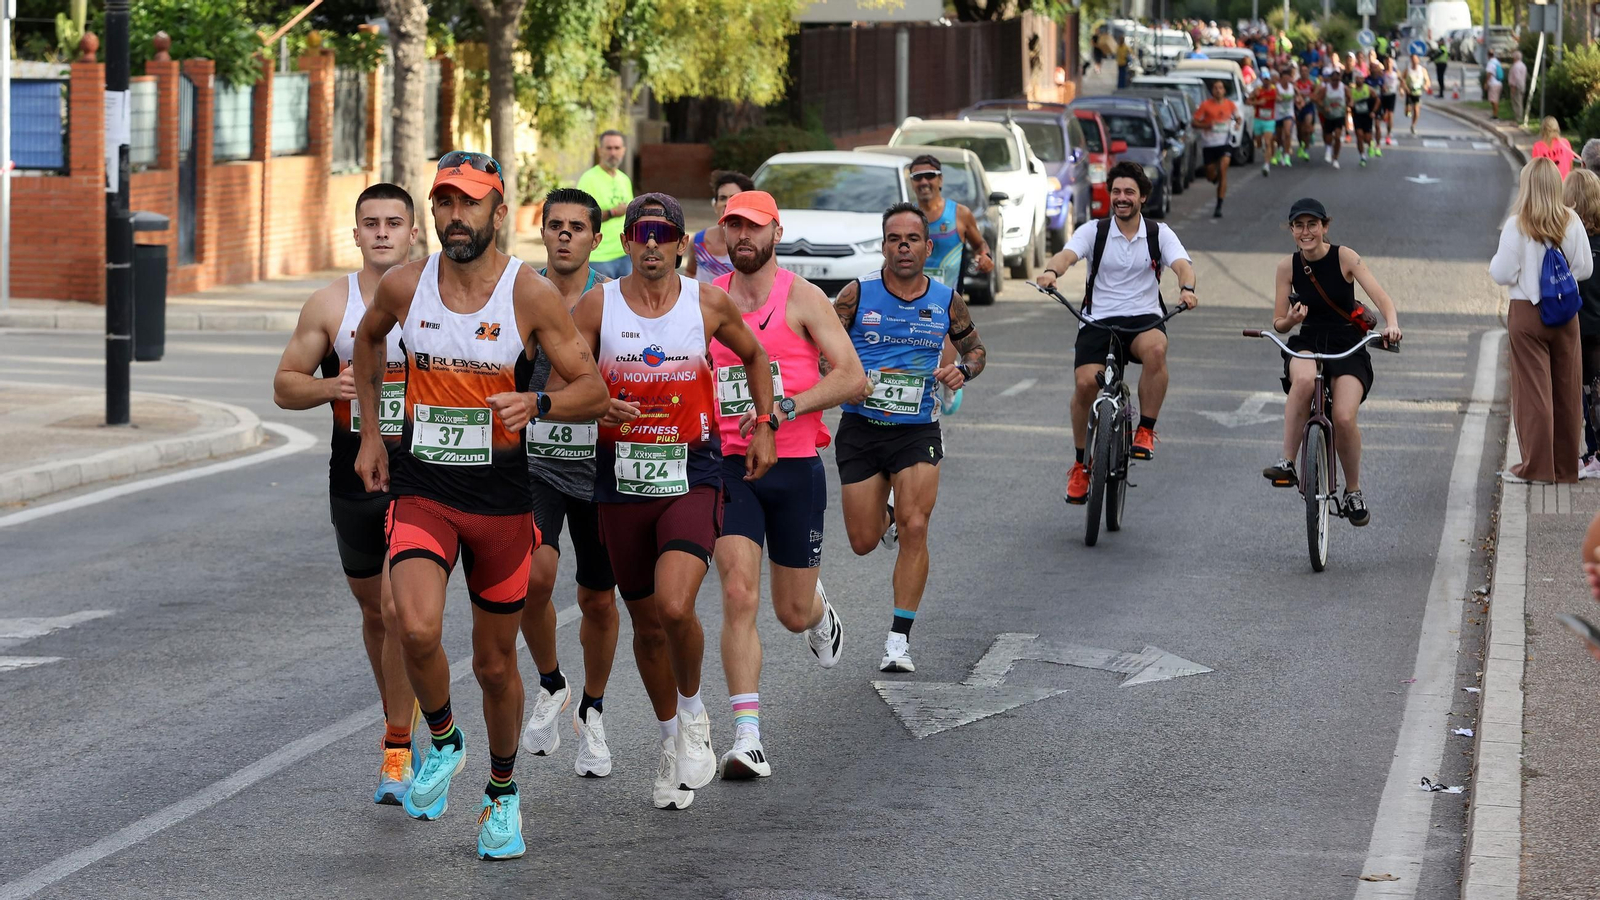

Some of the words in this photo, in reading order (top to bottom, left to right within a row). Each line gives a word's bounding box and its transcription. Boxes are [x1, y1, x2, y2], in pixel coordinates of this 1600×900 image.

[621, 331, 641, 339] GOBIK
[883, 335, 940, 348] RaceSplitter
[432, 357, 501, 371] RUBYSAN
[615, 353, 643, 362] triki
[664, 354, 690, 362] man
[623, 370, 697, 383] MOVITRANSA
[884, 386, 904, 401] 61
[438, 426, 465, 447] 37
[548, 425, 573, 443] 48
[631, 425, 679, 435] FITNESS
[632, 461, 669, 480] 124
